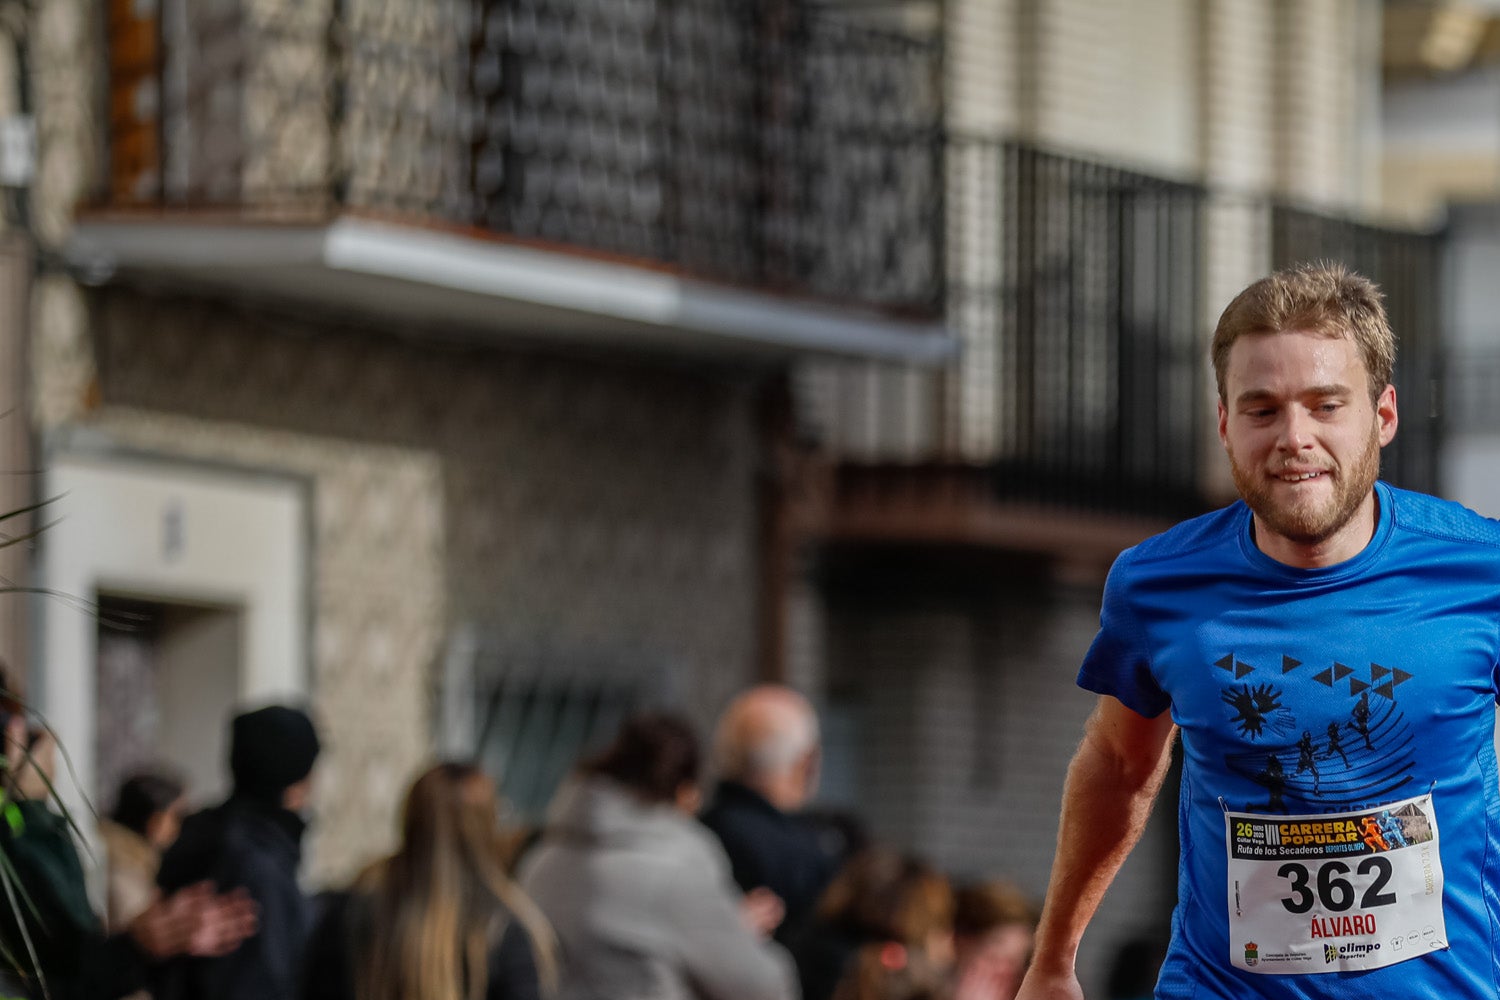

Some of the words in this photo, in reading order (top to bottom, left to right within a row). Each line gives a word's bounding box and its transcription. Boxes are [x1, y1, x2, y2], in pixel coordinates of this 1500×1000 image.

[1236, 822, 1253, 837] 26
[1264, 824, 1280, 845] VII
[1279, 820, 1357, 836] CARRERA
[1281, 832, 1358, 845] POPULAR
[1237, 845, 1253, 854] Ruta
[1254, 846, 1263, 855] de
[1264, 846, 1277, 856] los
[1279, 844, 1324, 855] Secaderos
[1325, 844, 1348, 854] DEPORTES
[1347, 842, 1365, 852] OLIMPO
[1277, 856, 1397, 914] 362
[1311, 914, 1377, 939] ÁLVARO
[1339, 943, 1381, 953] olimpo
